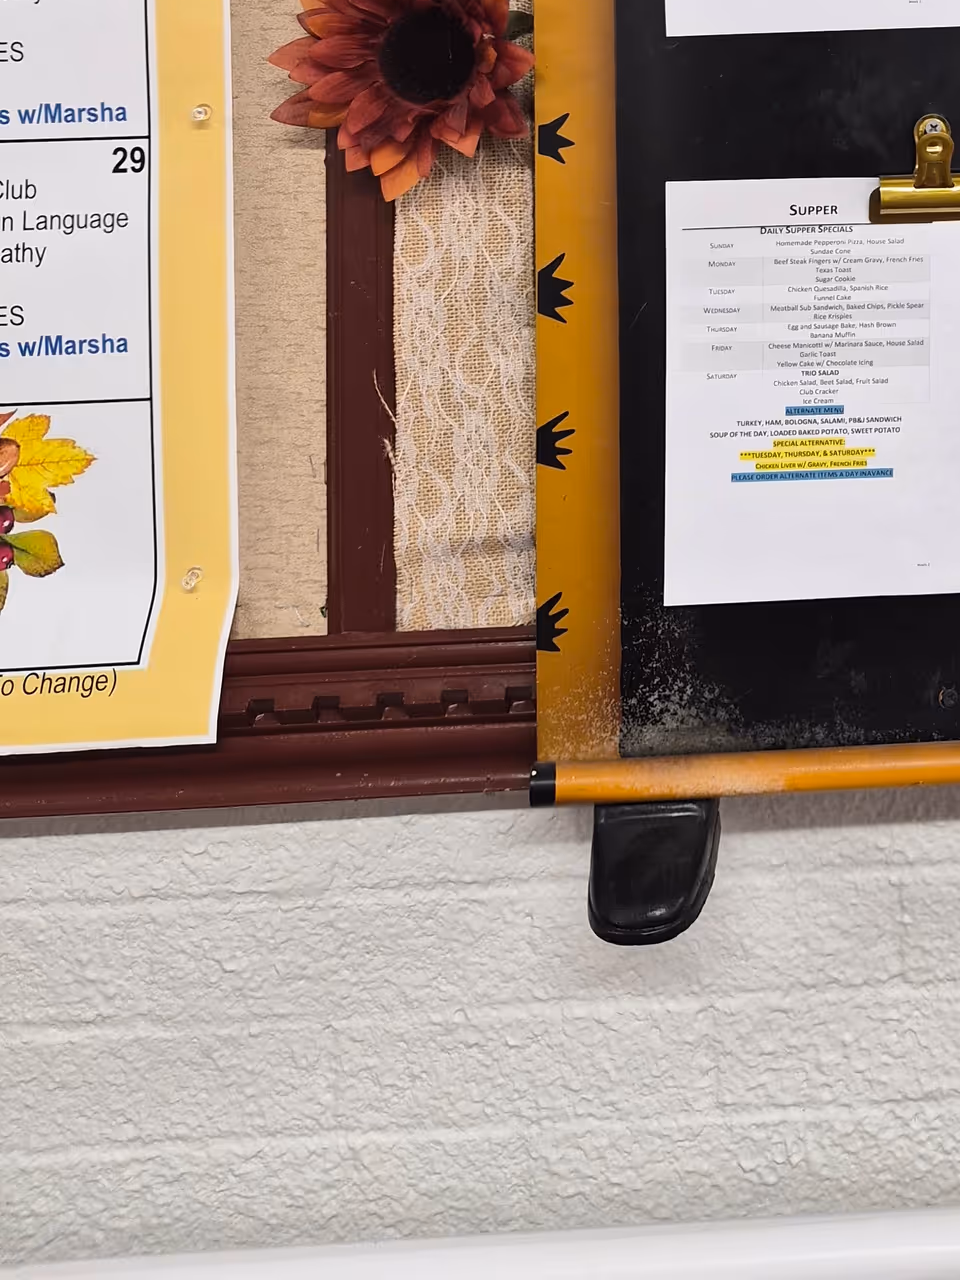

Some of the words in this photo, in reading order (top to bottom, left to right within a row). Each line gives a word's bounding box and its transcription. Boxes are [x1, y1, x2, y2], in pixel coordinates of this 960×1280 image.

[18, 102, 127, 124] w/Marsha
[112, 147, 145, 173] 29
[23, 211, 128, 235] Language
[18, 333, 128, 356] w/Marsha
[22, 669, 117, 698] Change)
